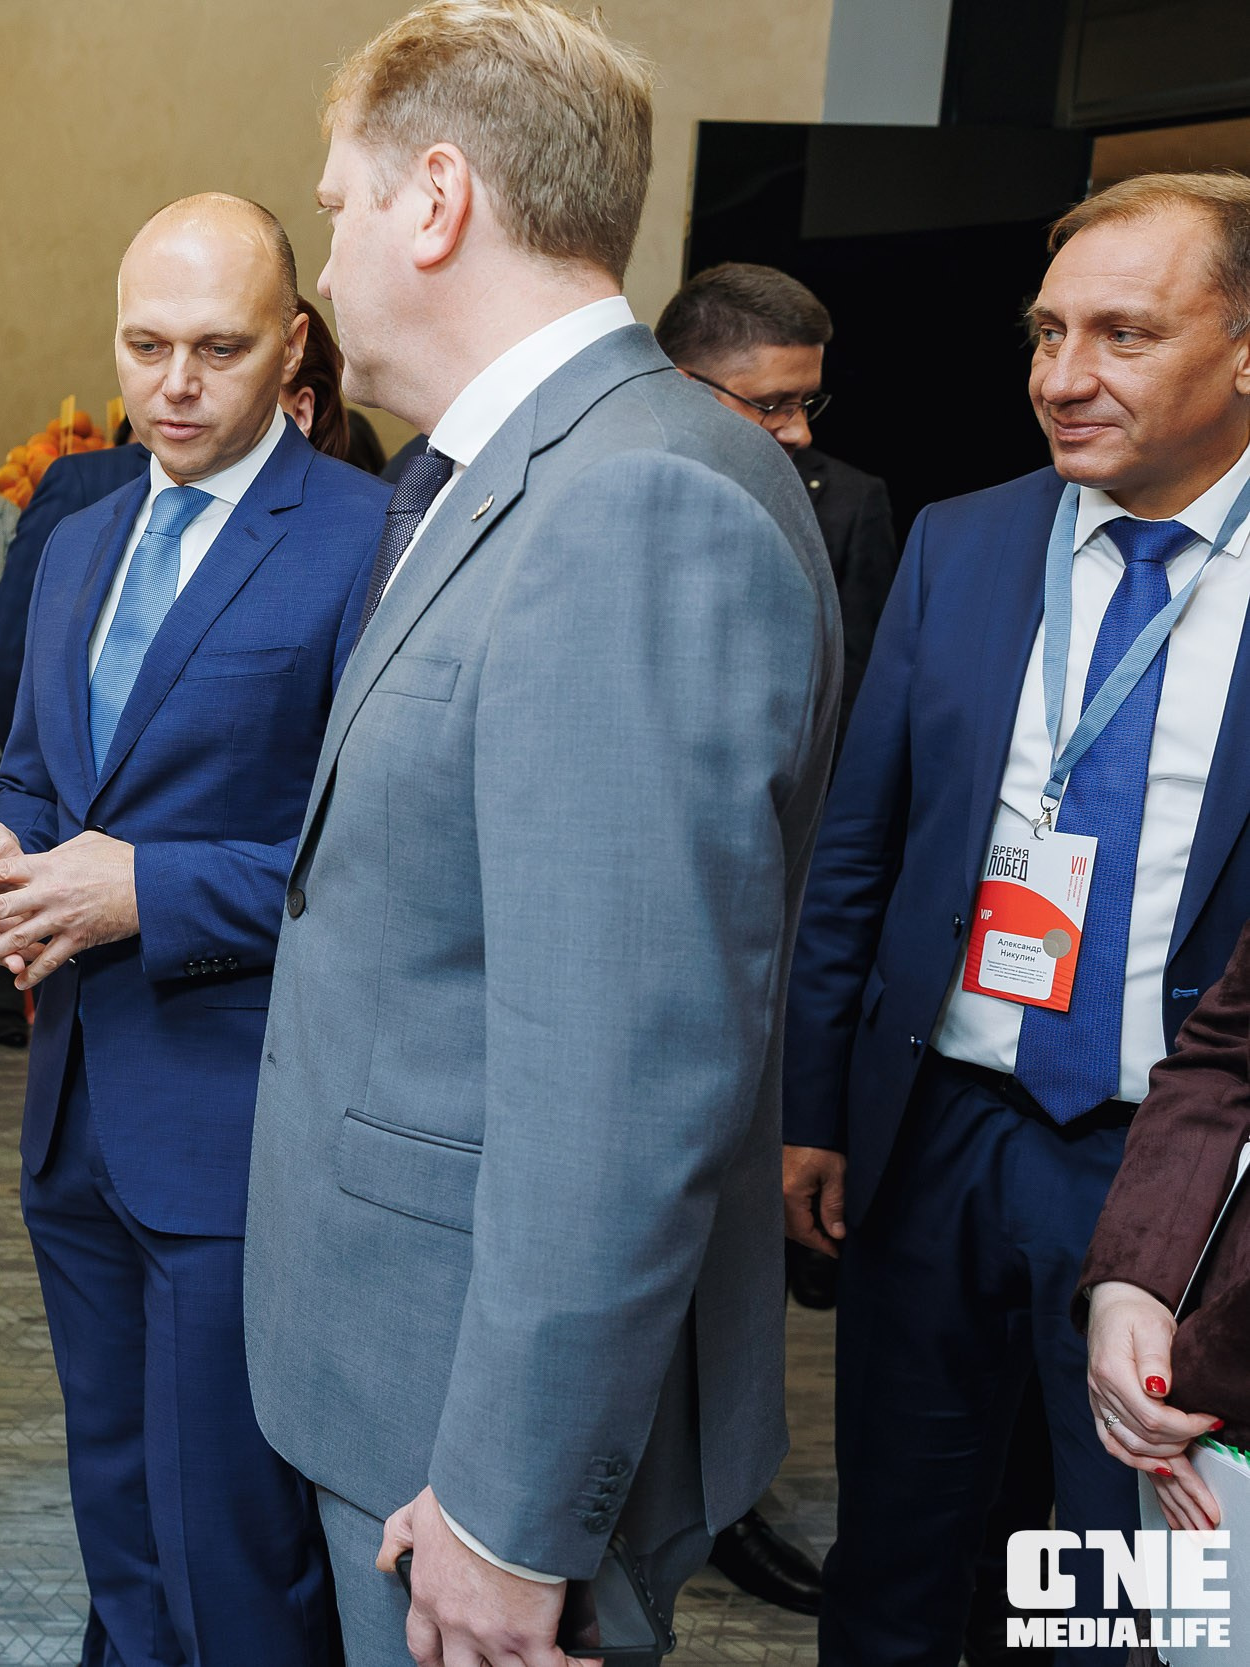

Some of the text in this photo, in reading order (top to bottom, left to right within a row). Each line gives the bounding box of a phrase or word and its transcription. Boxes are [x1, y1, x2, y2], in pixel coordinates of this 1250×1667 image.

[992, 845, 1029, 859] ВРЕМЯ
[987, 855, 1029, 882] ПОБЕД
[1071, 855, 1087, 876] VII
[980, 908, 993, 921] VIP
[997, 938, 1042, 953] Александр
[1000, 949, 1036, 963] Никулин
